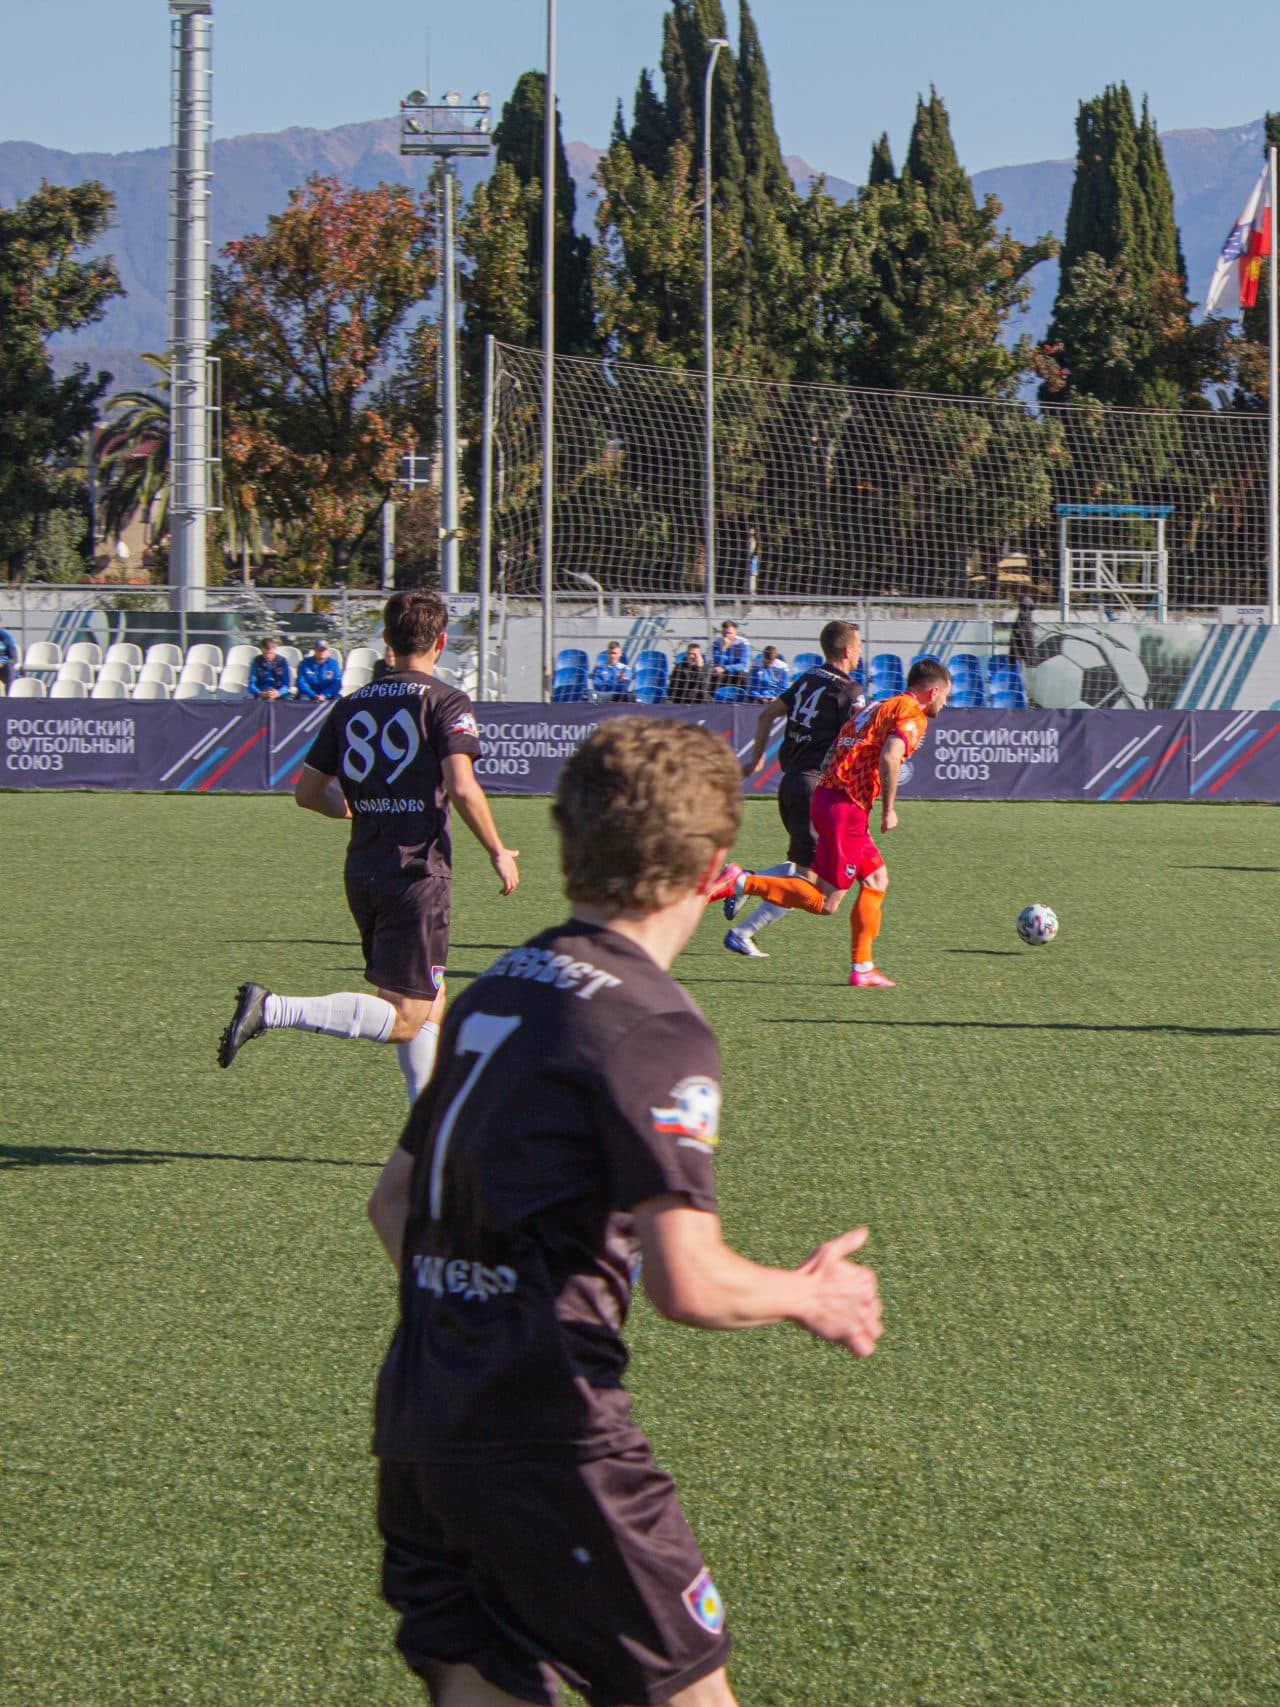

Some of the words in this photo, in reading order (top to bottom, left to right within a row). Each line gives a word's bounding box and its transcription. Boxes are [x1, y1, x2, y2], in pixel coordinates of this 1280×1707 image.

[789, 681, 827, 729] 14
[6, 717, 136, 736] РОССИЙСКИЙ
[6, 736, 136, 754] ФУТБОЛЬНЫЙ
[343, 708, 420, 784] 89
[935, 728, 1060, 746] РОССИЙСКИЙ
[6, 754, 64, 771] СОЮЗ
[935, 745, 1060, 763] ФУТБОЛЬНЫЙ
[474, 758, 530, 775] СОЮЗ
[935, 764, 990, 780] СОЮЗ
[430, 1011, 522, 1220] 7
